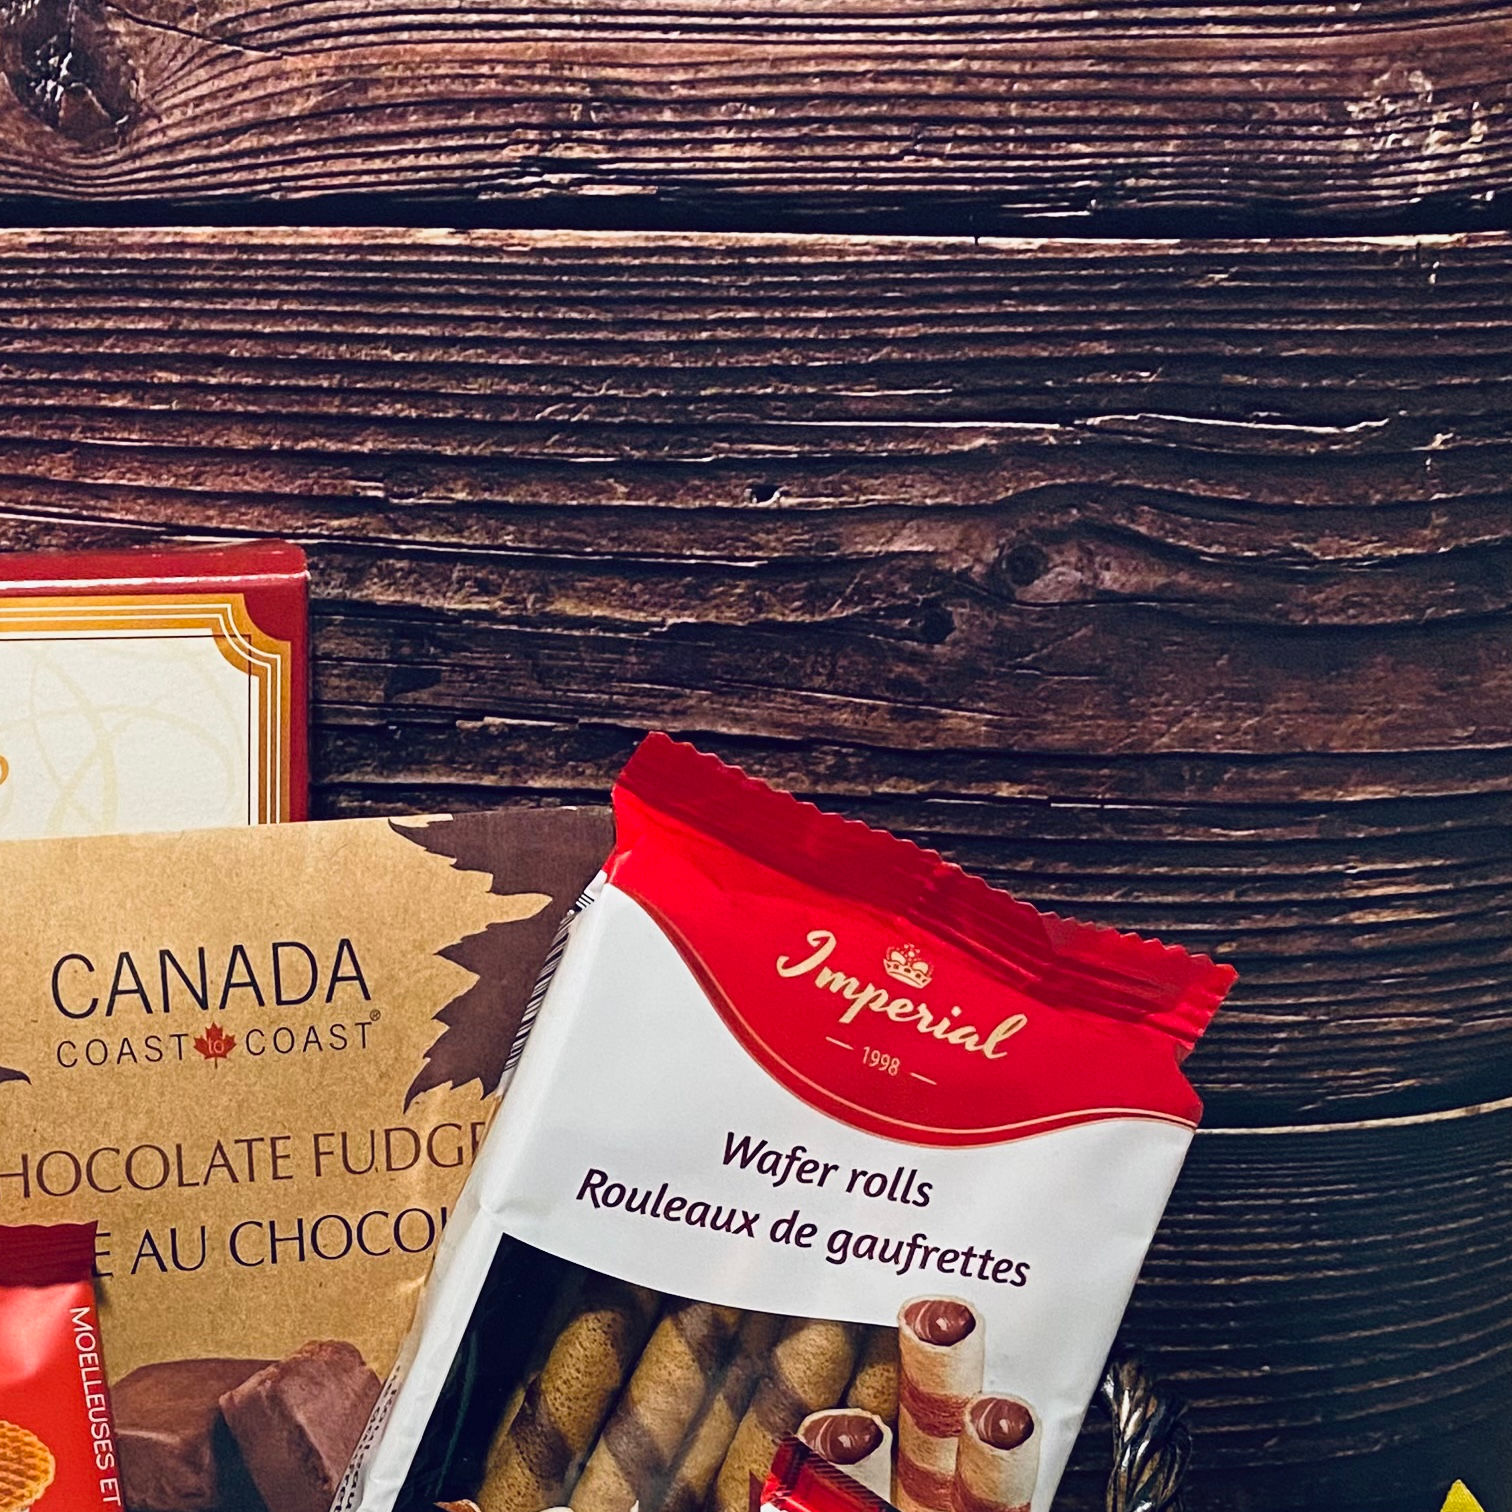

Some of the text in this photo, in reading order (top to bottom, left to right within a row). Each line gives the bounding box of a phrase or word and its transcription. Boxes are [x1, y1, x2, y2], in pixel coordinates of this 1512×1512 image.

[52, 938, 371, 1019] CANADA
[776, 929, 1028, 1059] Imperial
[57, 1033, 188, 1067] COAST
[208, 1037, 225, 1054] to
[862, 1046, 901, 1077] 1998
[723, 1132, 933, 1208] Wafer rolls
[131, 1226, 206, 1275] AU
[576, 1168, 1031, 1288] Rouleaux de gaufrettes
[69, 1306, 116, 1471] MOELLEUSES
[100, 1477, 122, 1507] ET
